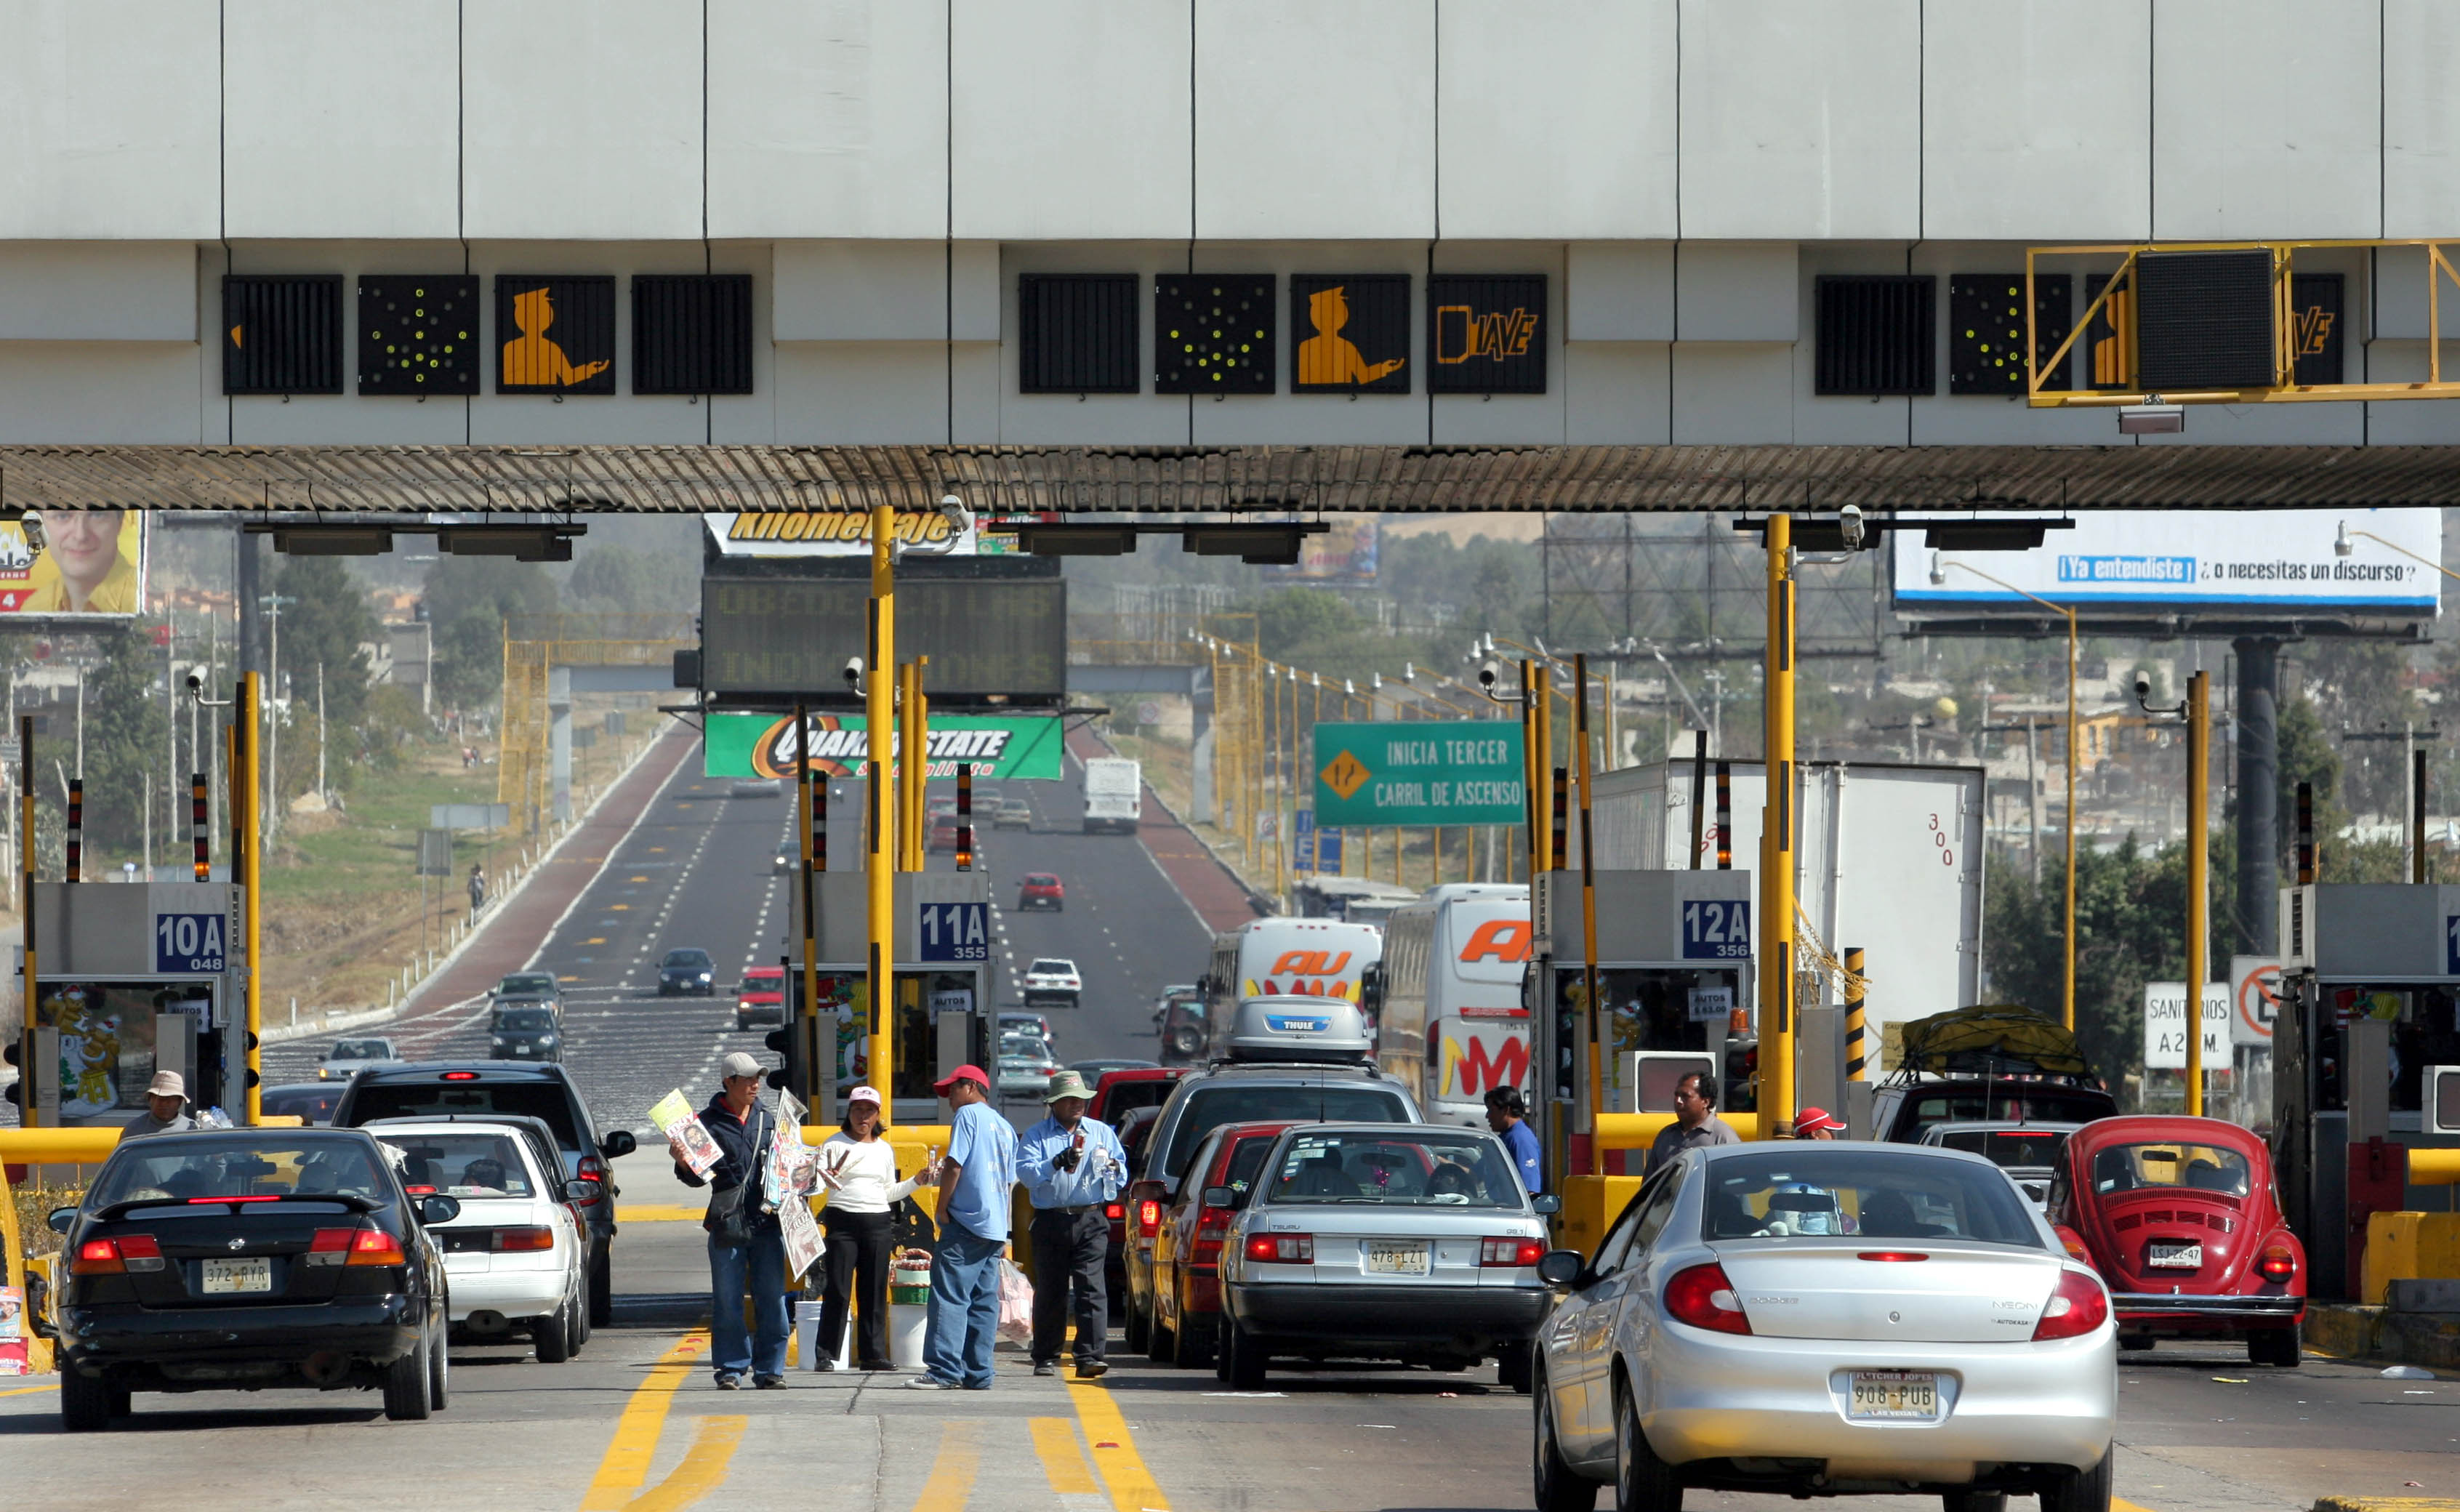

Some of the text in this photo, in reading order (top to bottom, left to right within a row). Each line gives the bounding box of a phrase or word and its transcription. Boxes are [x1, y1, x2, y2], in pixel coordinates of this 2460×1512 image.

[2094, 557, 2183, 579] entendiste
[2214, 563, 2223, 579] o
[2229, 560, 2307, 580] necesitas
[2311, 563, 2329, 580] un
[2334, 560, 2403, 581] discurso
[926, 729, 1012, 757] STATE
[1386, 739, 1508, 765] INICIA TERCER
[1375, 781, 1521, 807] CARRIL DE ASCENSO
[922, 904, 985, 945] 11A
[1686, 903, 1748, 943] 12A
[159, 916, 222, 956] 10A
[954, 946, 986, 959] 355
[1716, 945, 1748, 957] 356
[190, 958, 222, 970] 048
[1270, 950, 1353, 976] AU
[934, 997, 965, 1006] AUTOS
[1283, 1021, 1314, 1031] THULE
[2158, 1032, 2171, 1053] A
[207, 1266, 265, 1282] 372-RYR
[1992, 1300, 2038, 1309] NEON
[1856, 1385, 1932, 1405] 908-PUB
